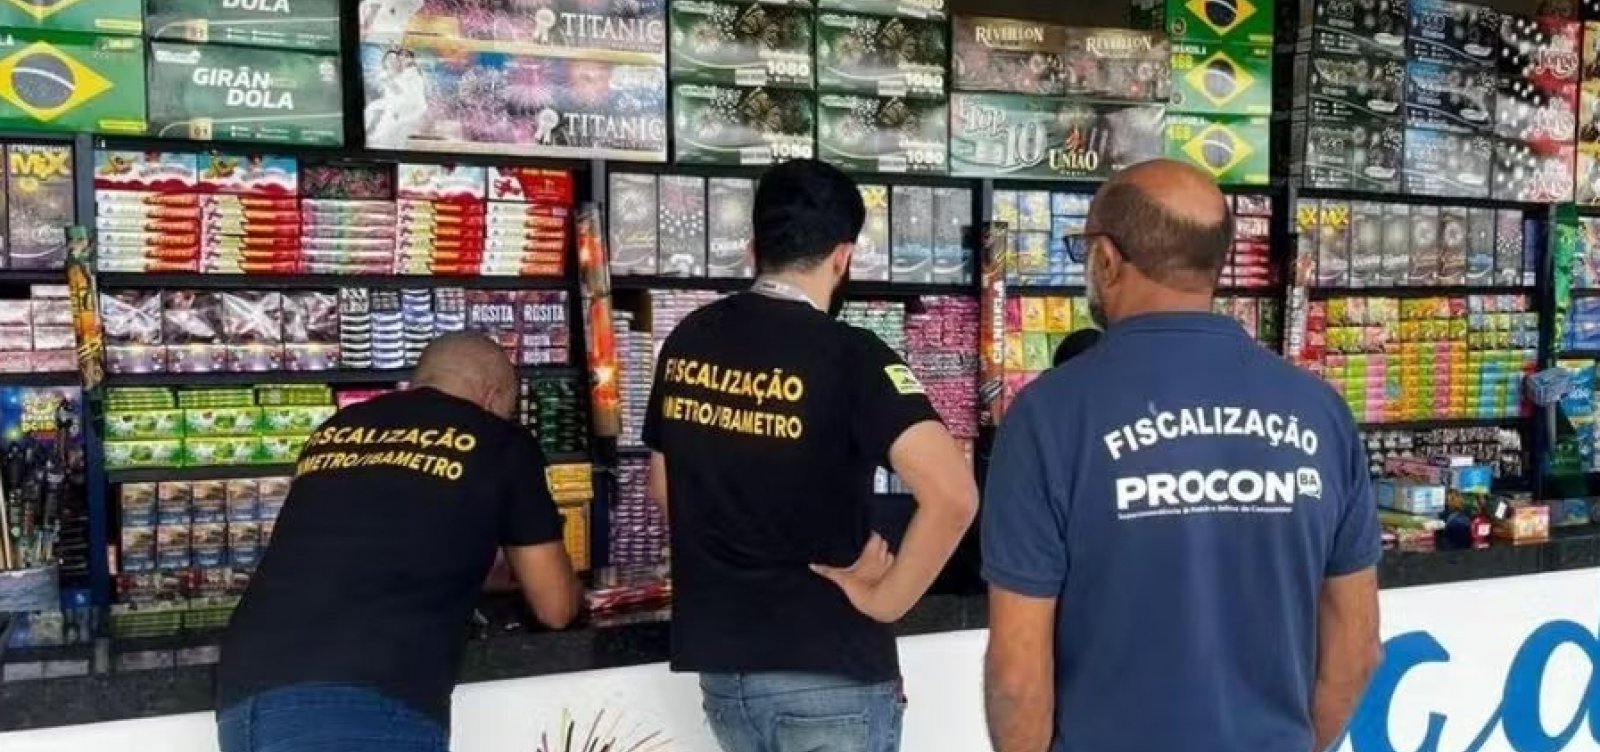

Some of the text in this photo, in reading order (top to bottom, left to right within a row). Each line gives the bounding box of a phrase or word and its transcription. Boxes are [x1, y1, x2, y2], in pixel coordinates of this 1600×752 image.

[561, 12, 663, 43] TITANIC
[226, 88, 294, 110] DOLA
[564, 112, 664, 142] TITANIC
[472, 304, 514, 322] ROSITA
[523, 304, 566, 322] ROSITA
[665, 358, 804, 405] FISCALIZAÇÃO
[1103, 406, 1319, 460] FISCALIZAÇÃO
[1115, 469, 1295, 510] PROCON
[1299, 473, 1318, 487] BA
